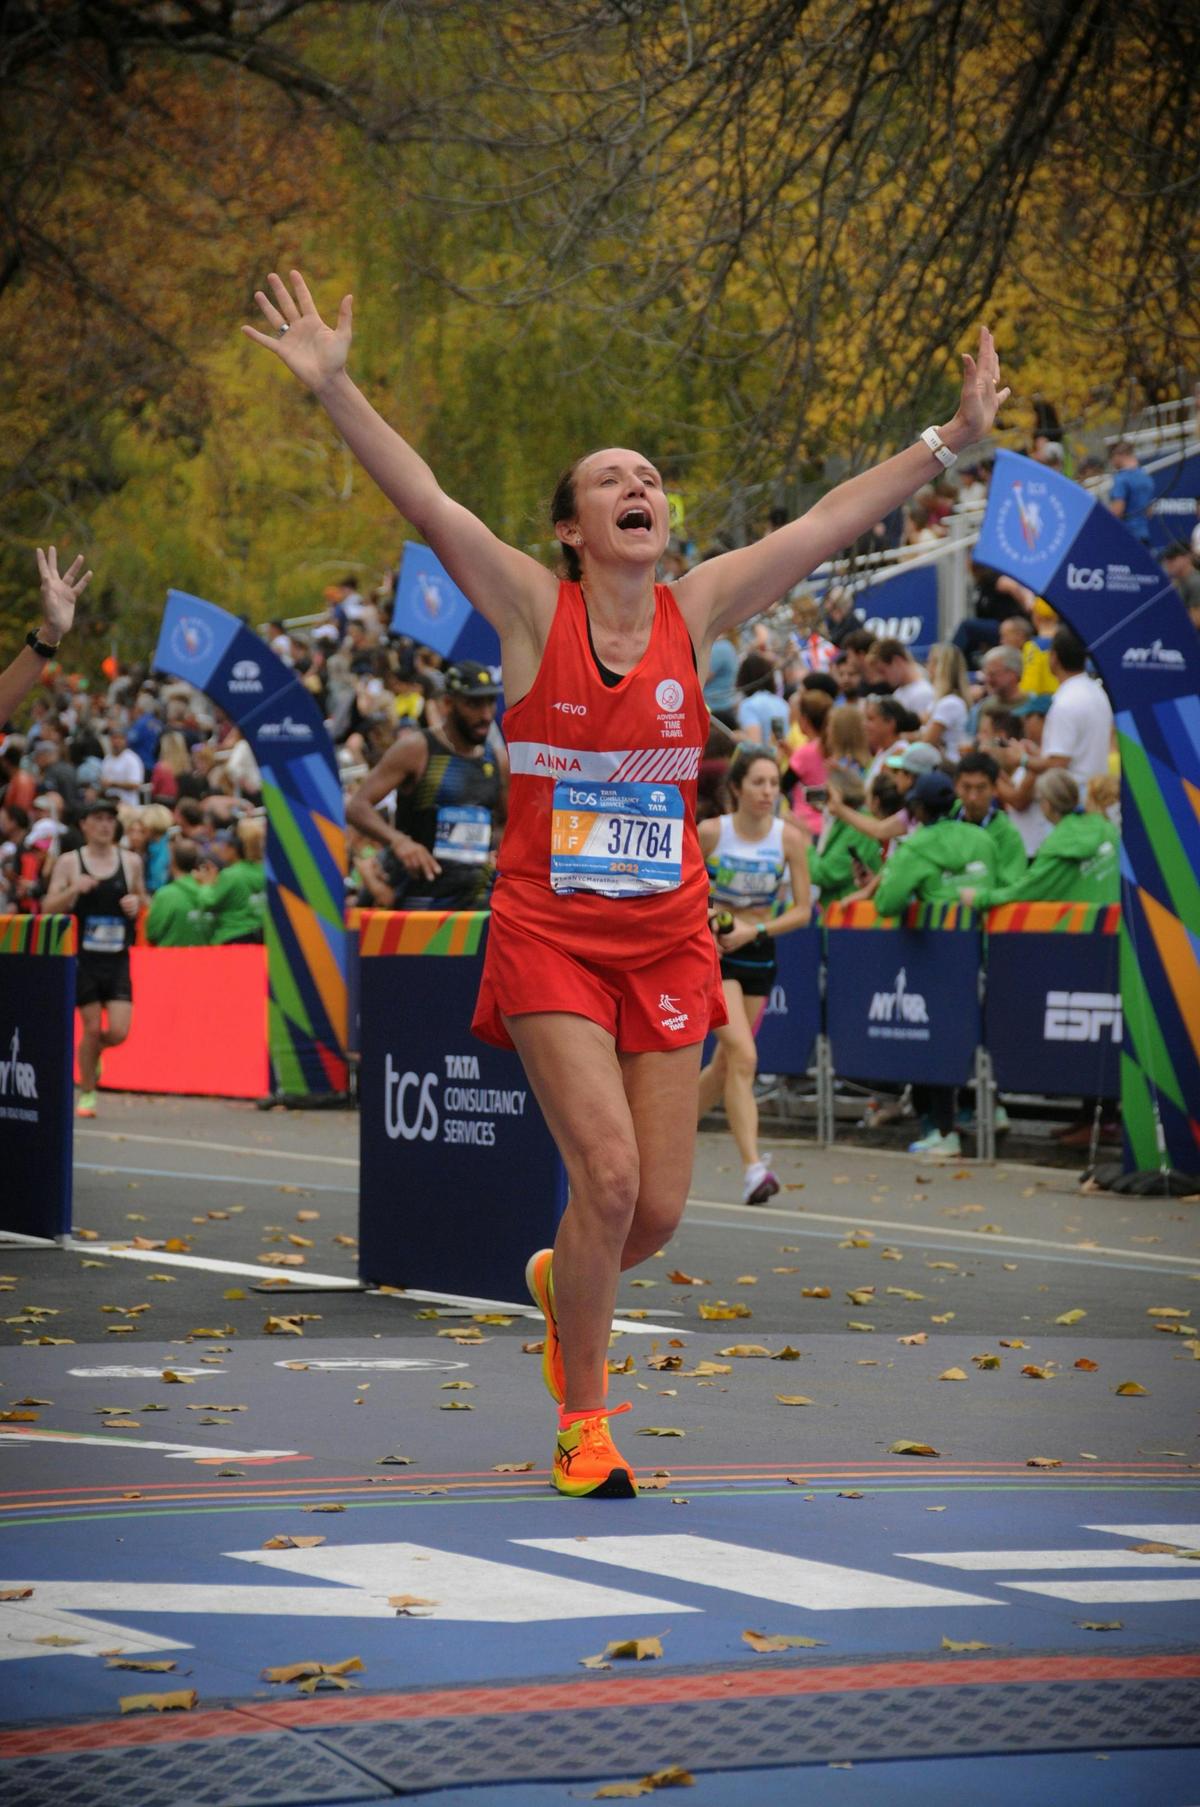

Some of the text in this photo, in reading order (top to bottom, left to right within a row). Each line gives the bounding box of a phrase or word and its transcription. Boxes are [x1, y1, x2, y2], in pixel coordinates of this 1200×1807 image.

[1067, 563, 1104, 591] tcs
[561, 703, 587, 716] EVO
[660, 729, 683, 738] TRAVEL
[664, 720, 681, 729] TIME
[534, 752, 582, 772] ANNA
[569, 787, 598, 806] tcs
[648, 804, 667, 812] TATA
[569, 815, 579, 829] 3
[568, 836, 579, 849] F
[607, 818, 672, 859] 37764
[444, 1055, 480, 1080] TATA
[385, 1053, 439, 1141] tcs
[444, 1087, 526, 1115] CONSULTANCY
[443, 1119, 496, 1146] SERVICES
